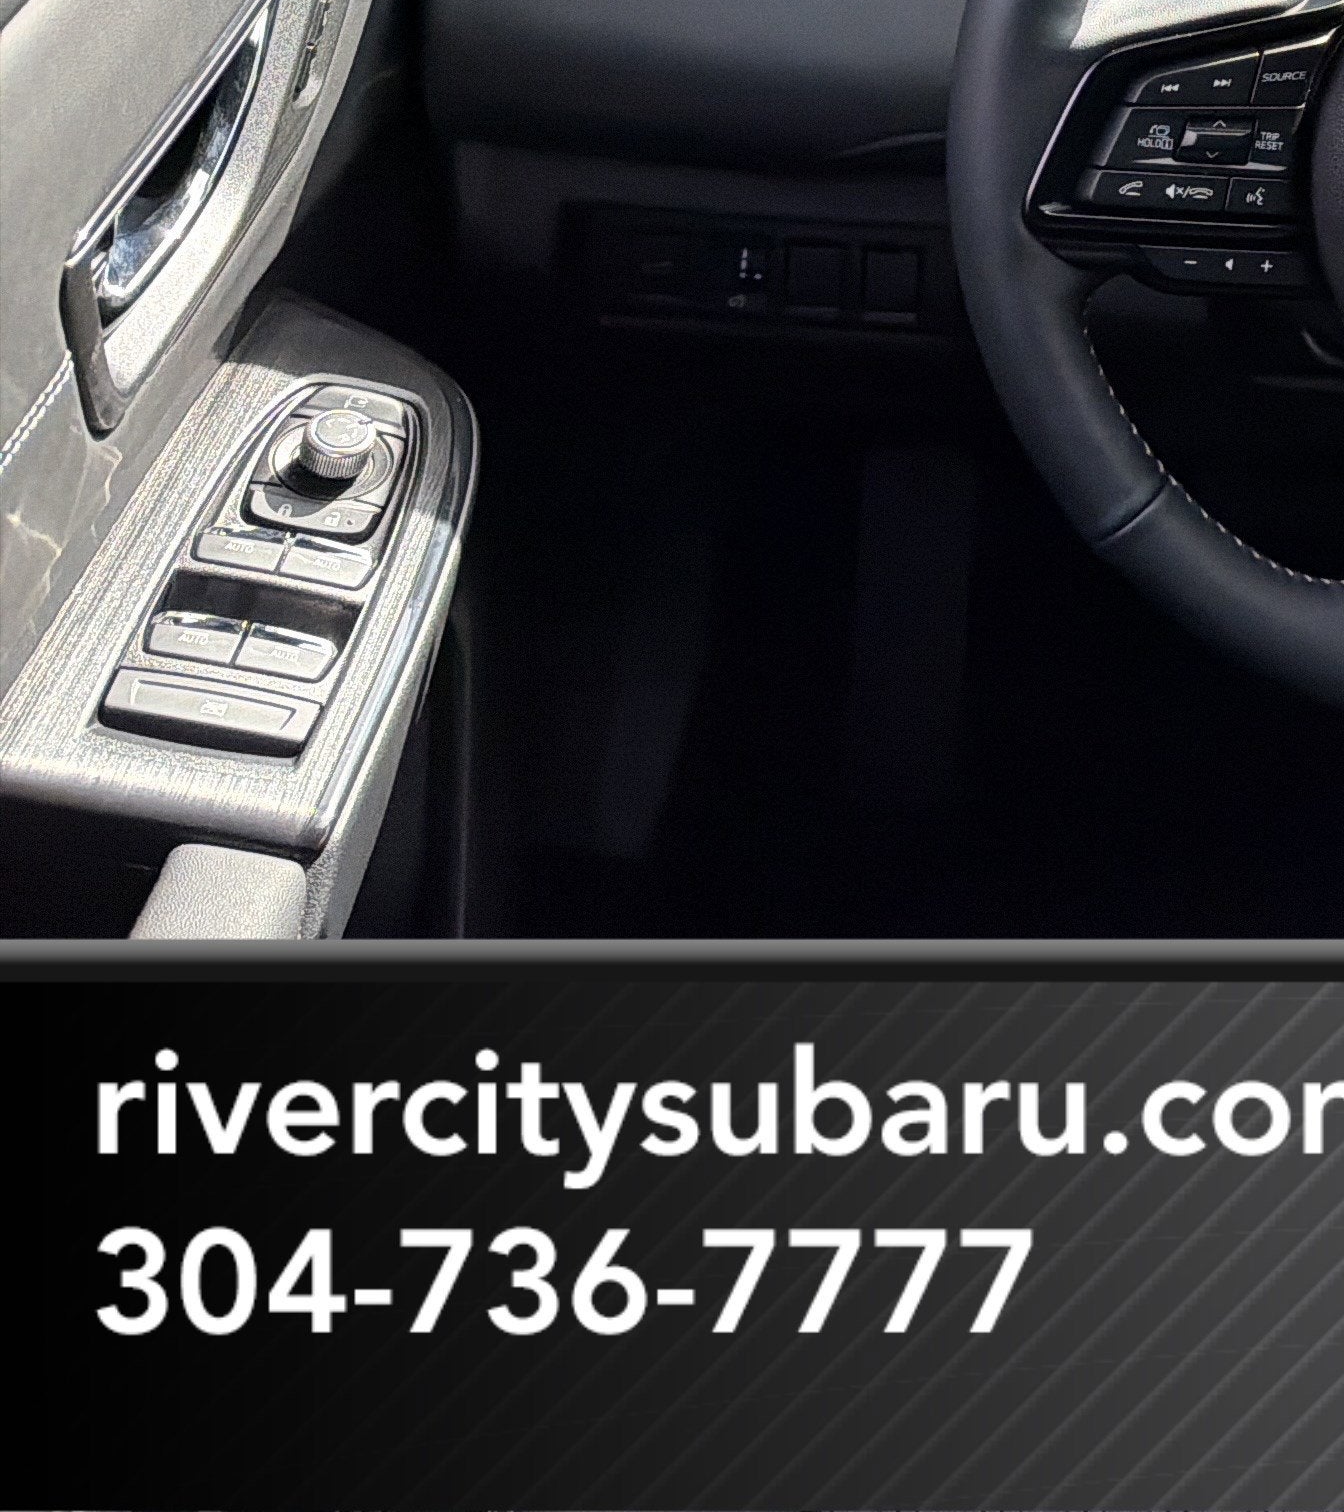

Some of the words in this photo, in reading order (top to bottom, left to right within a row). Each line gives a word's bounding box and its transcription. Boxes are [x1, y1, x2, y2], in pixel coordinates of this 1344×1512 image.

[1261, 71, 1308, 84] SOURCE
[1260, 131, 1281, 141] TRIP
[1255, 141, 1285, 152] RESET
